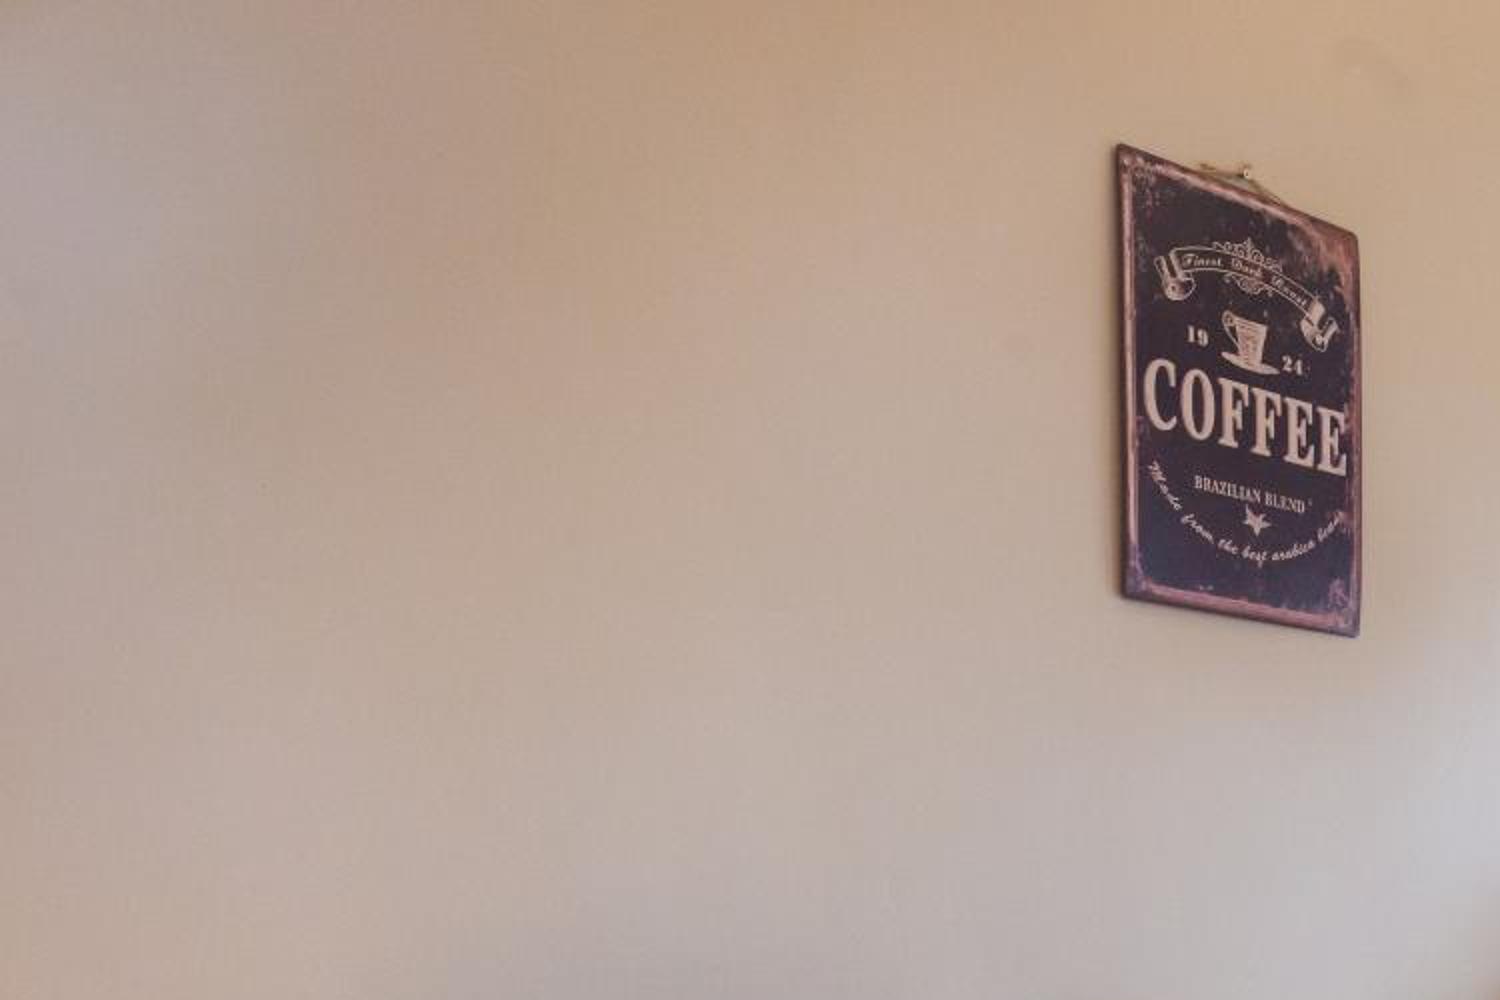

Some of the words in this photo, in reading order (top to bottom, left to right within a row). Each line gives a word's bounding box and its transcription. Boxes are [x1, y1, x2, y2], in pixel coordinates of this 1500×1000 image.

[1186, 325, 1209, 347] 19
[1282, 355, 1303, 375] 24
[1143, 358, 1348, 477] COFFEE
[1194, 475, 1262, 504] BRAZILIAN
[1264, 491, 1305, 514] BLEND
[1218, 539, 1239, 555] the
